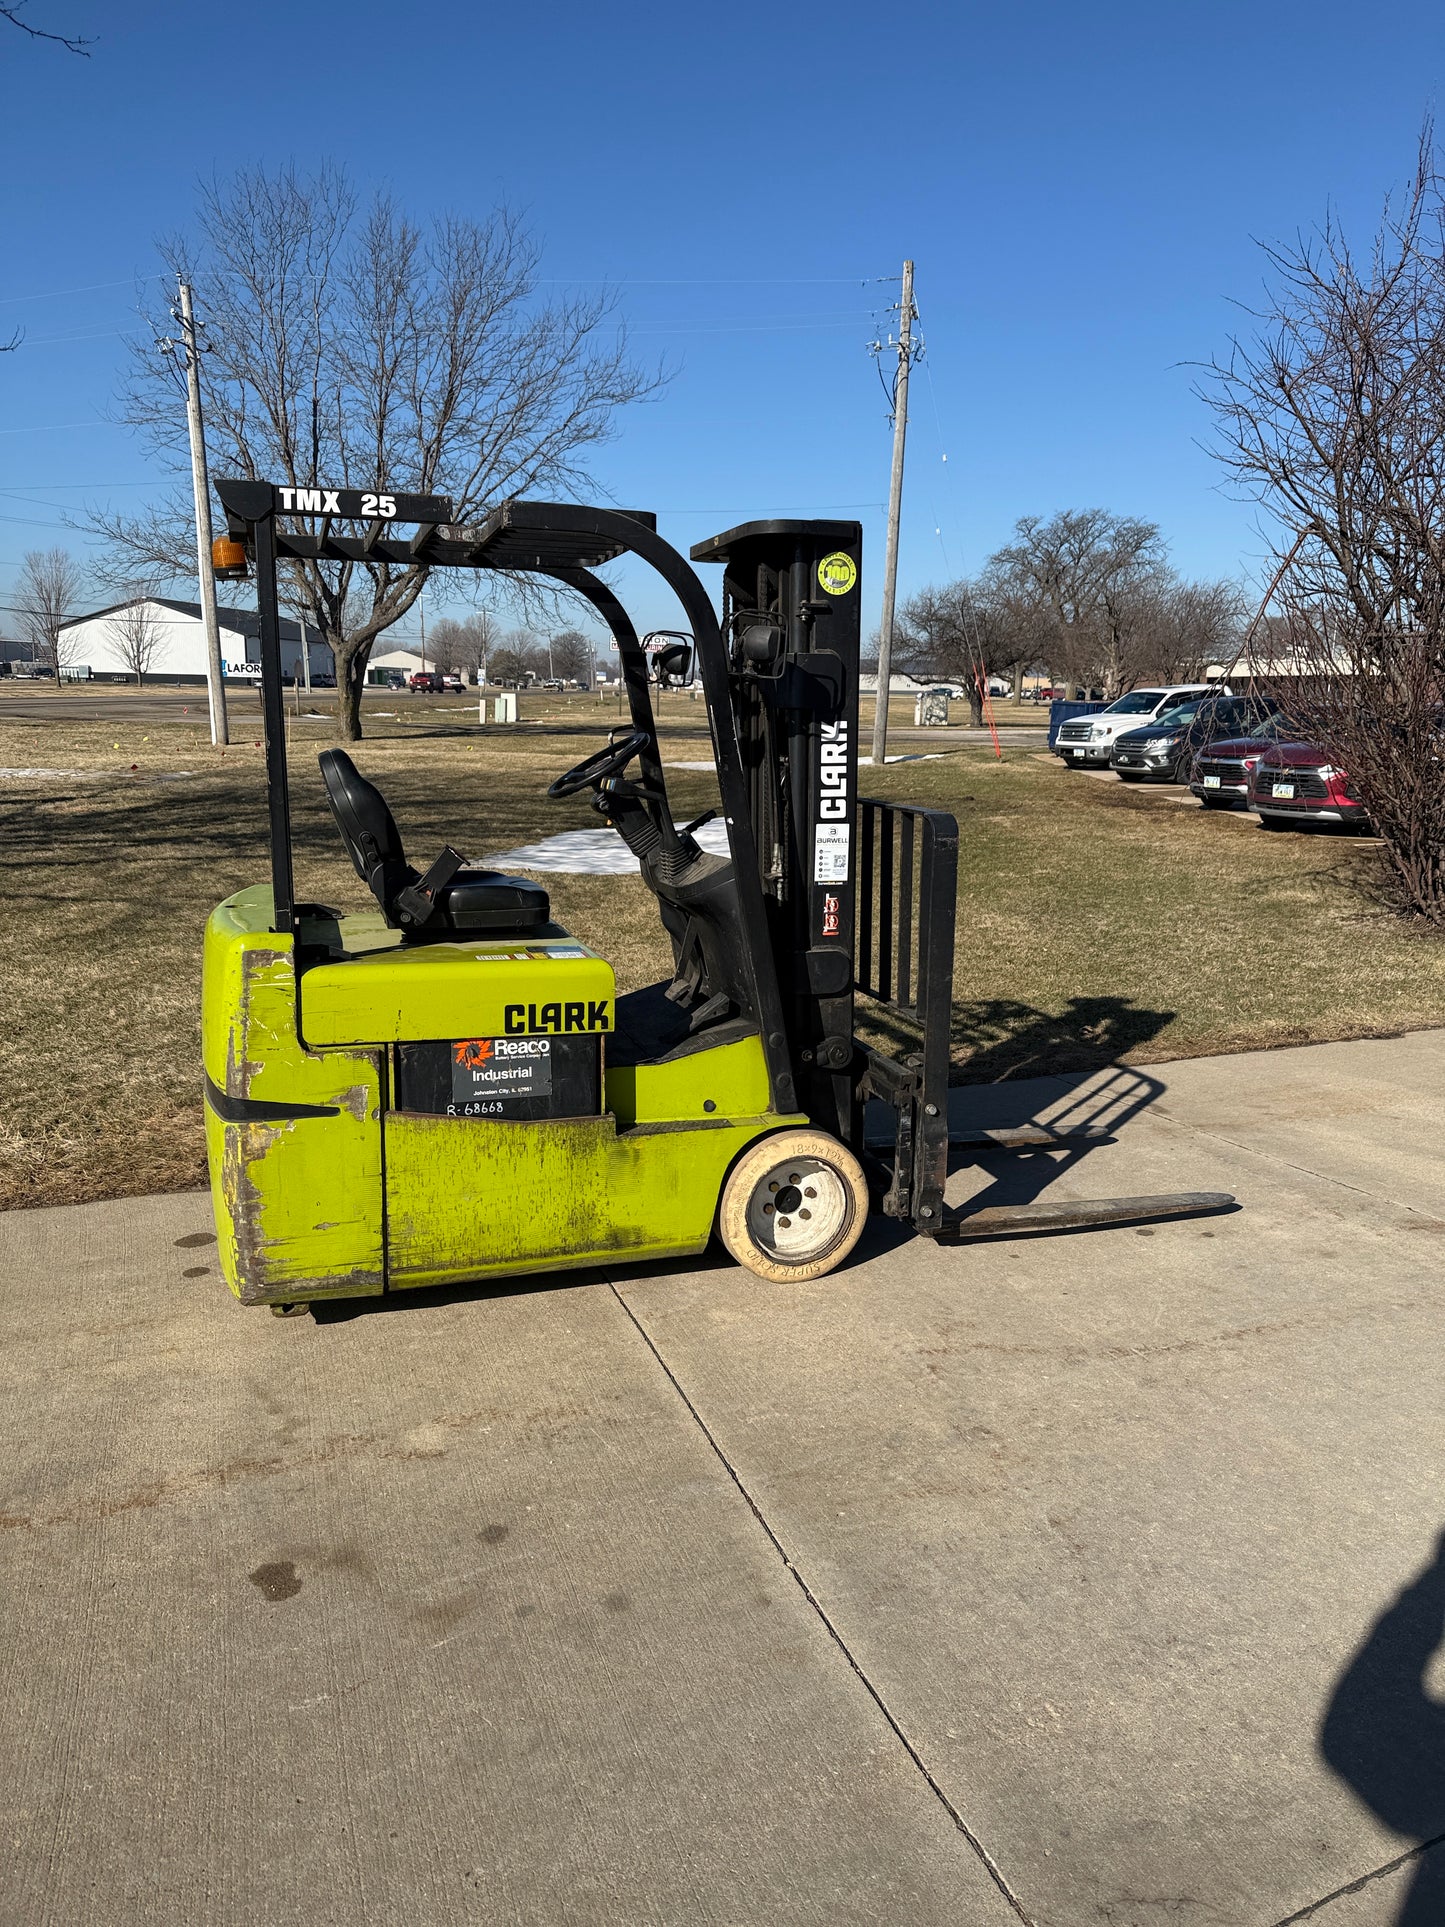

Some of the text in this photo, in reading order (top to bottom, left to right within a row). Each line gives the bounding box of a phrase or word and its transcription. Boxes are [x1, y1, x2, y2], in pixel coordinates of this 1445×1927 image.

[279, 488, 397, 517] TMX 25
[820, 720, 847, 819] CLARK
[504, 1001, 609, 1034] CLARK
[494, 1039, 550, 1056] Reaco
[472, 1066, 533, 1082] Industrial
